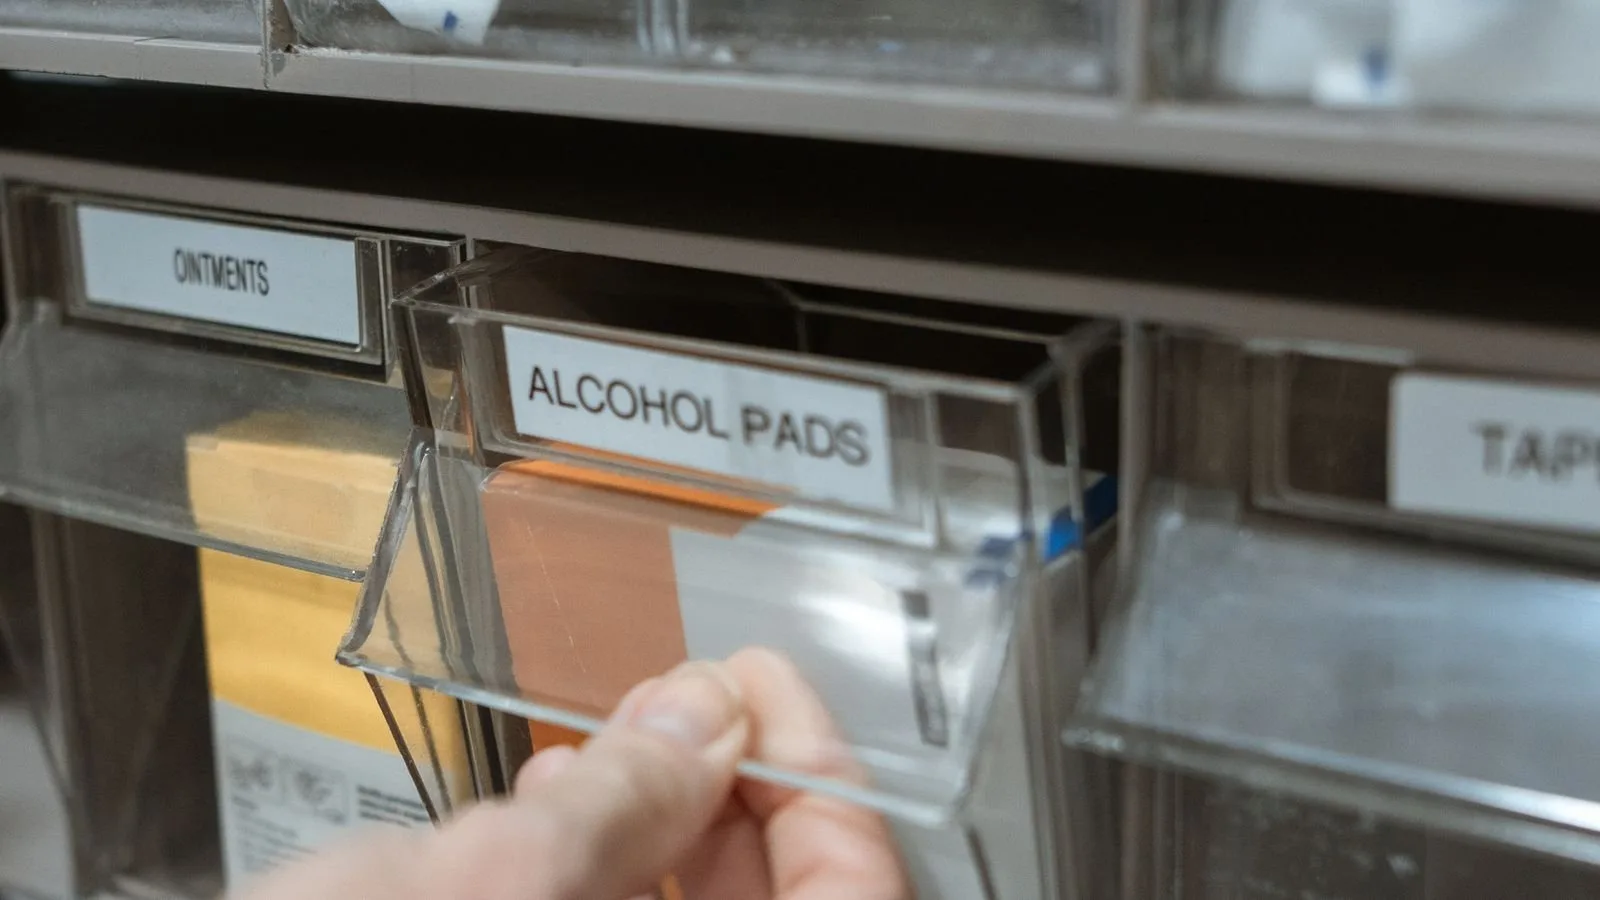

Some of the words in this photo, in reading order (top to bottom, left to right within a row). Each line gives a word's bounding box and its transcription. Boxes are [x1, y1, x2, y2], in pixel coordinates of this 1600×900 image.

[174, 247, 270, 297] OINTMENTS
[528, 365, 730, 441] ALCOHOL
[740, 404, 872, 467] PADS
[1468, 419, 1600, 486] TAP
